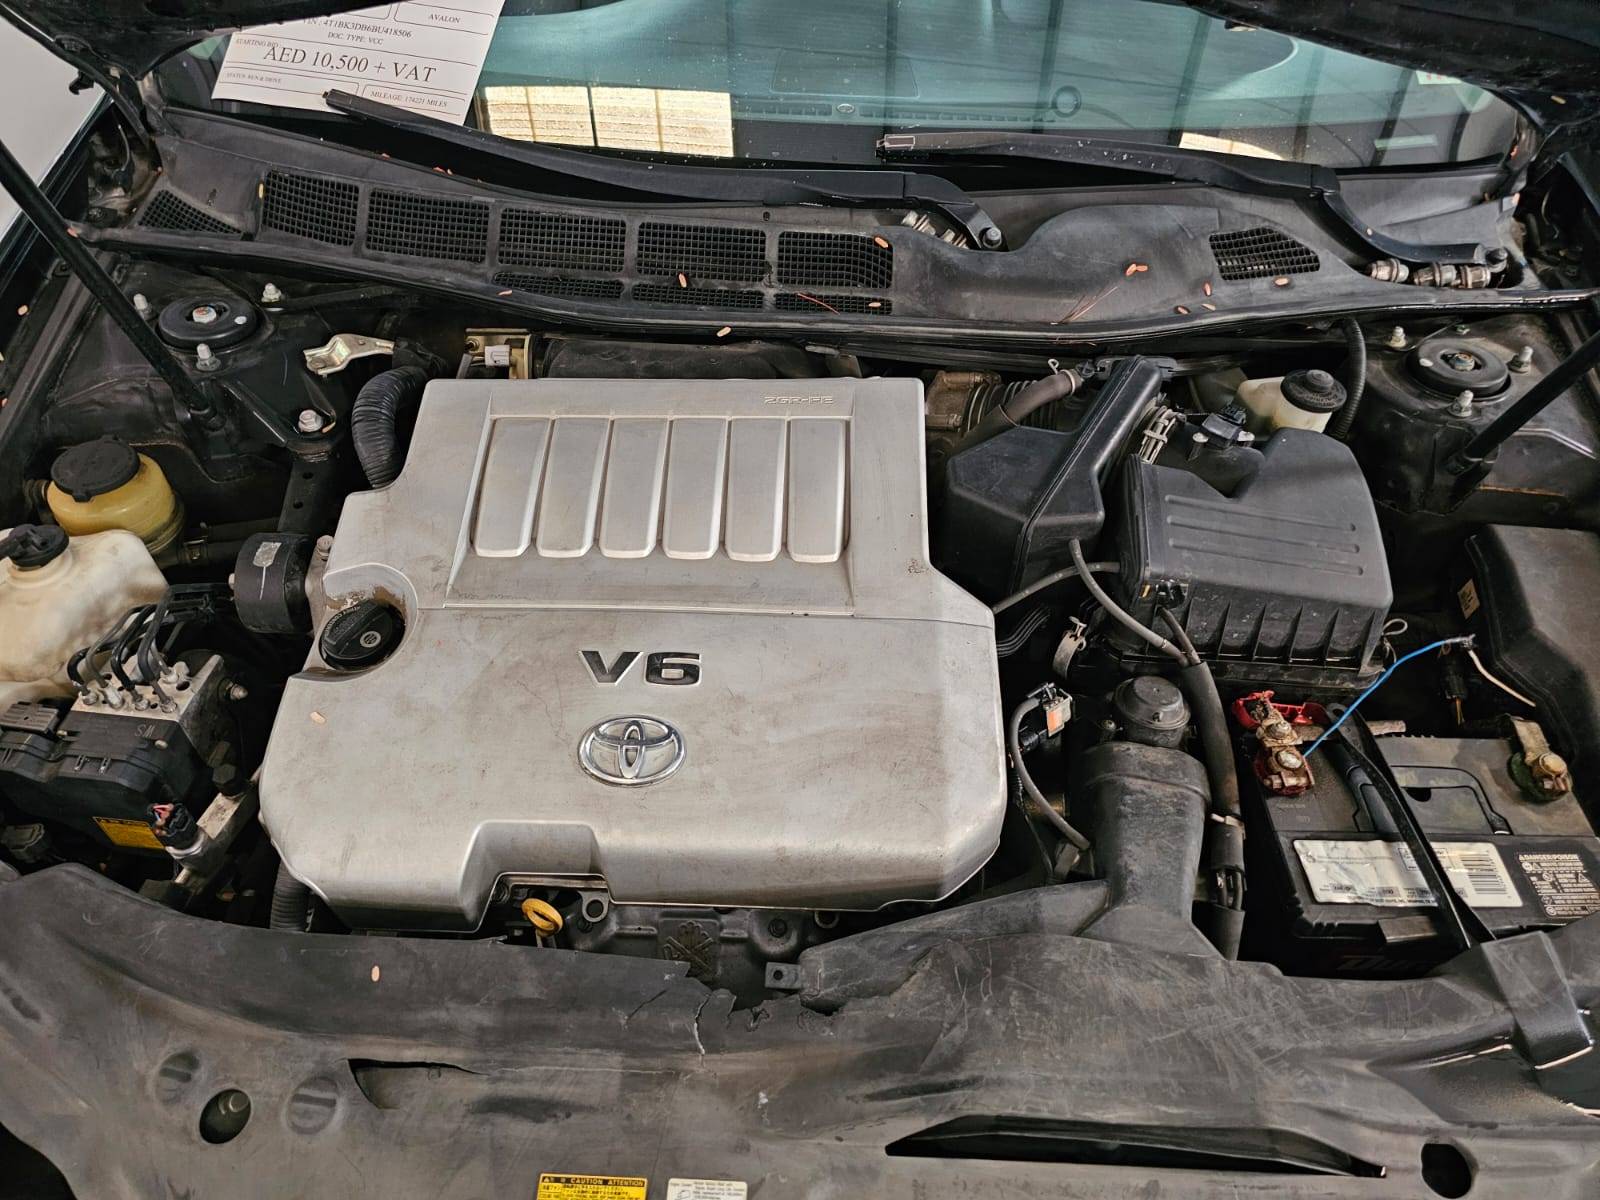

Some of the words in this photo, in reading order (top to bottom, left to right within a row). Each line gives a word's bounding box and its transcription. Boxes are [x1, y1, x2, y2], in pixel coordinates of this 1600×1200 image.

[429, 13, 460, 24] AVALON
[263, 46, 307, 64] AED
[312, 51, 369, 72] 10,500
[374, 62, 386, 73] +
[393, 62, 437, 81] VAT
[578, 650, 701, 686] V6
[570, 1177, 604, 1185] CAUTION
